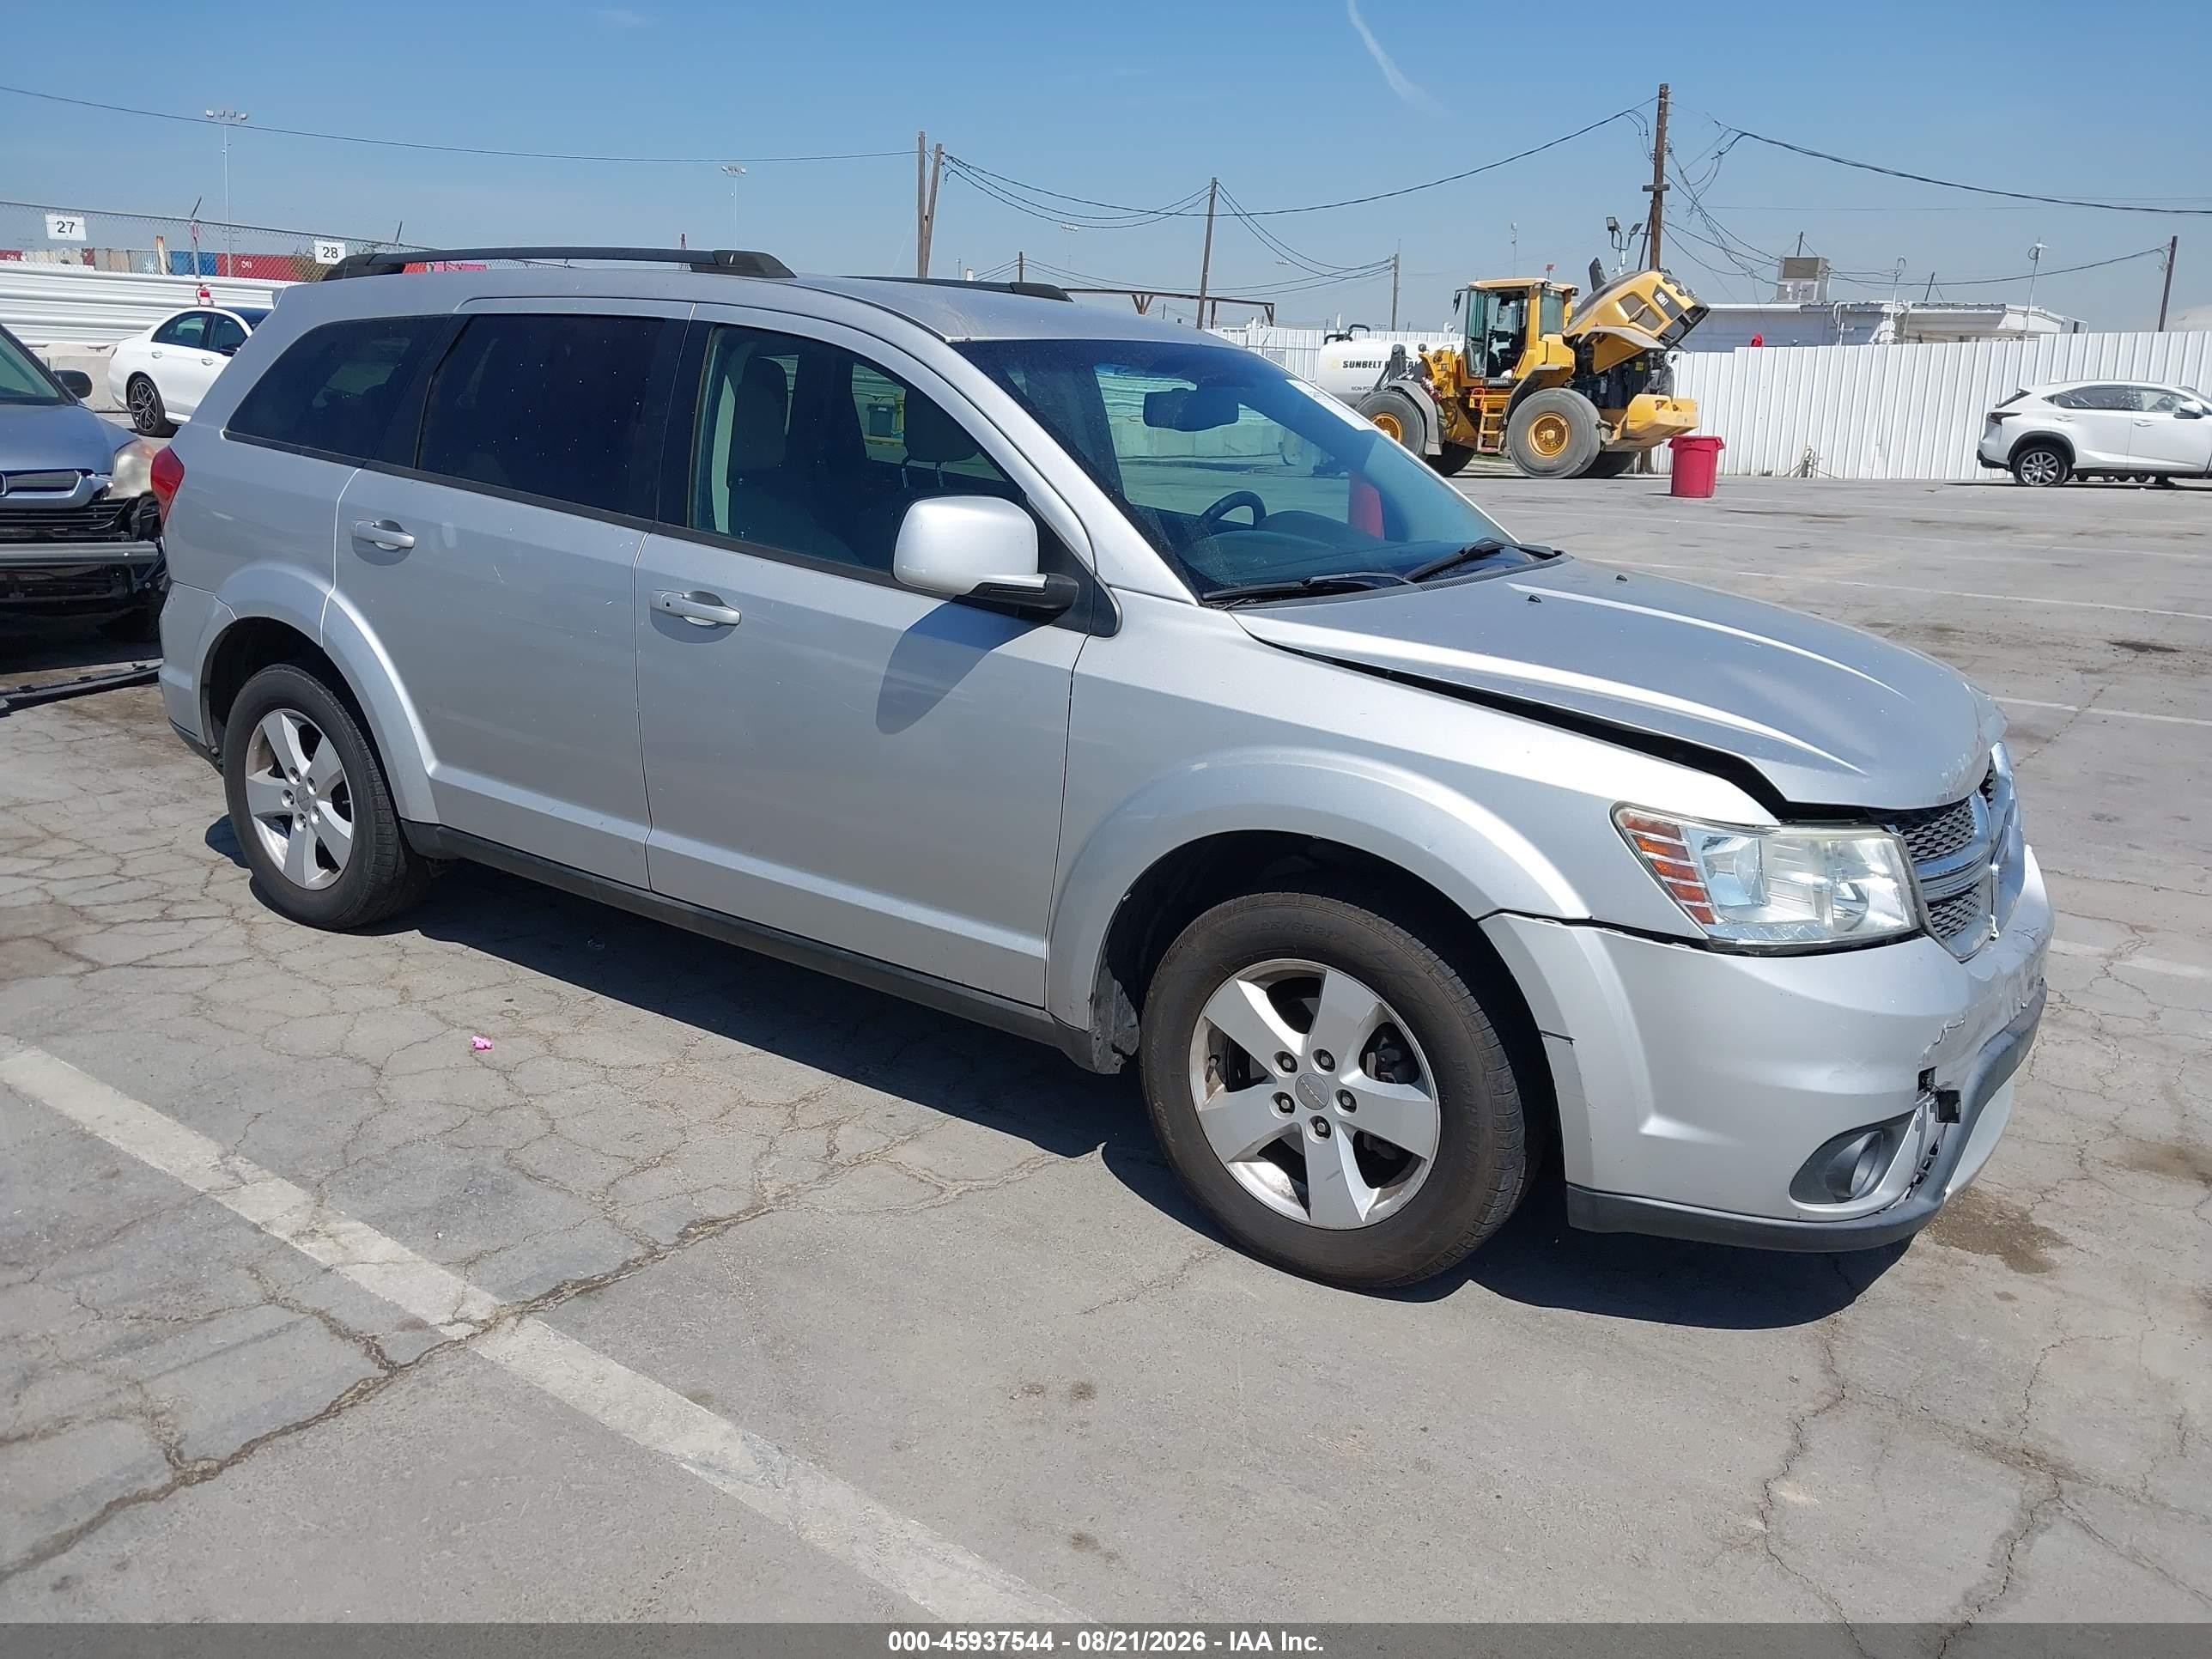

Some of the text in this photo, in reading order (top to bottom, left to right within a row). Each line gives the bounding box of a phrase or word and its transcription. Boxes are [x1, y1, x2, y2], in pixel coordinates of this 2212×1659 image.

[56, 220, 76, 234] 27
[322, 246, 339, 258] 28
[1342, 360, 1382, 369] SUNBELT
